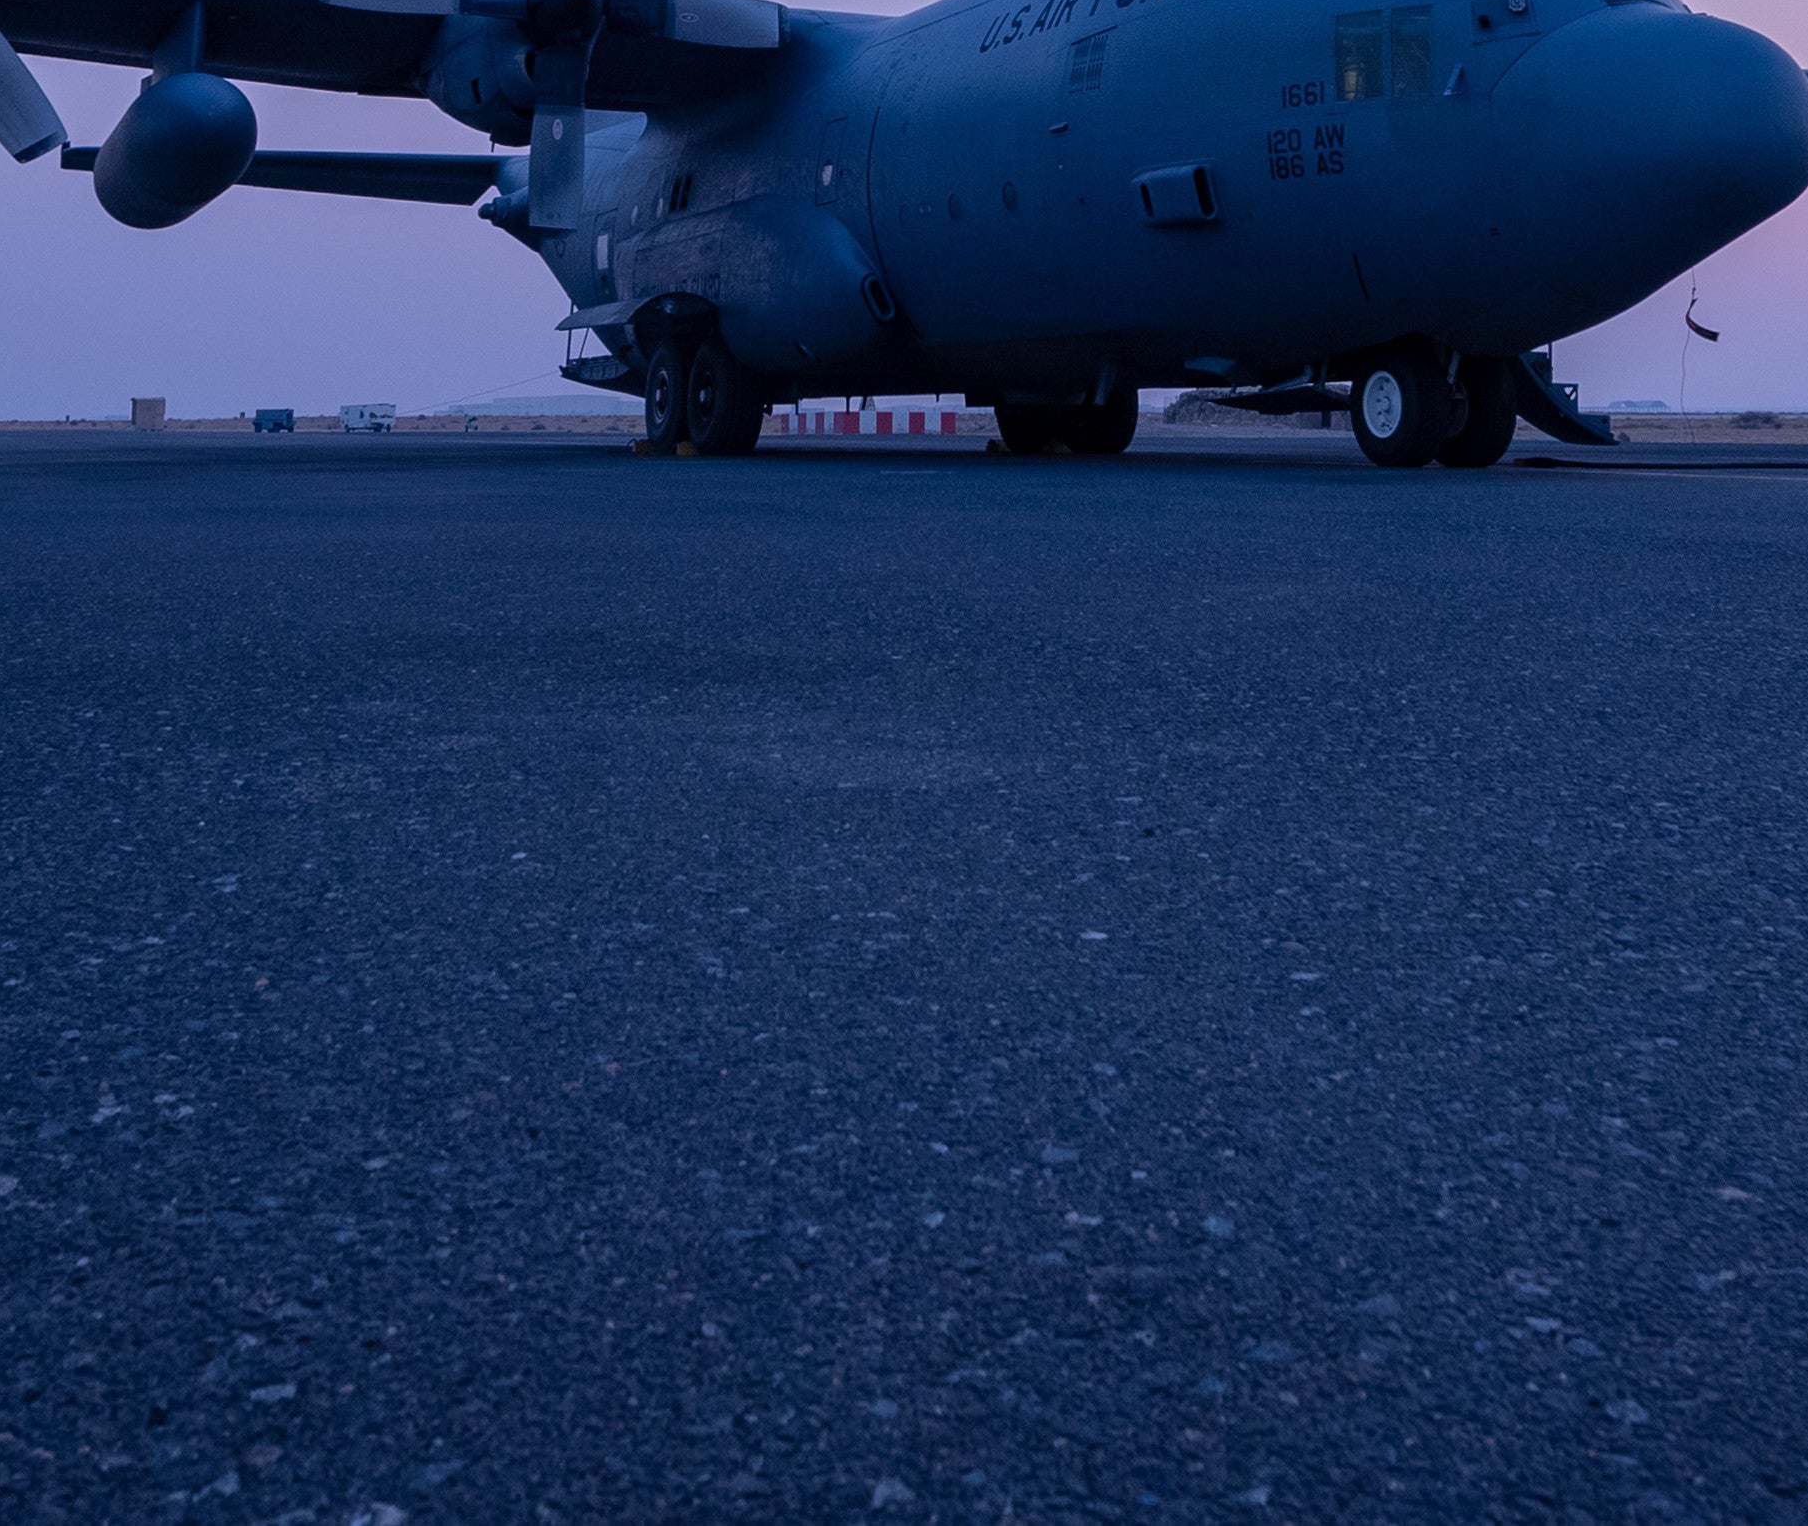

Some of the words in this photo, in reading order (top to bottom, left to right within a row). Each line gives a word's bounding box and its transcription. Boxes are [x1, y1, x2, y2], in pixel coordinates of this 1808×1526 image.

[979, 4, 1031, 53] U.S.
[1282, 81, 1325, 108] 1661
[1267, 127, 1301, 155] 120
[1314, 123, 1344, 150] AW
[1269, 154, 1305, 180] 186
[1317, 150, 1344, 175] AS
